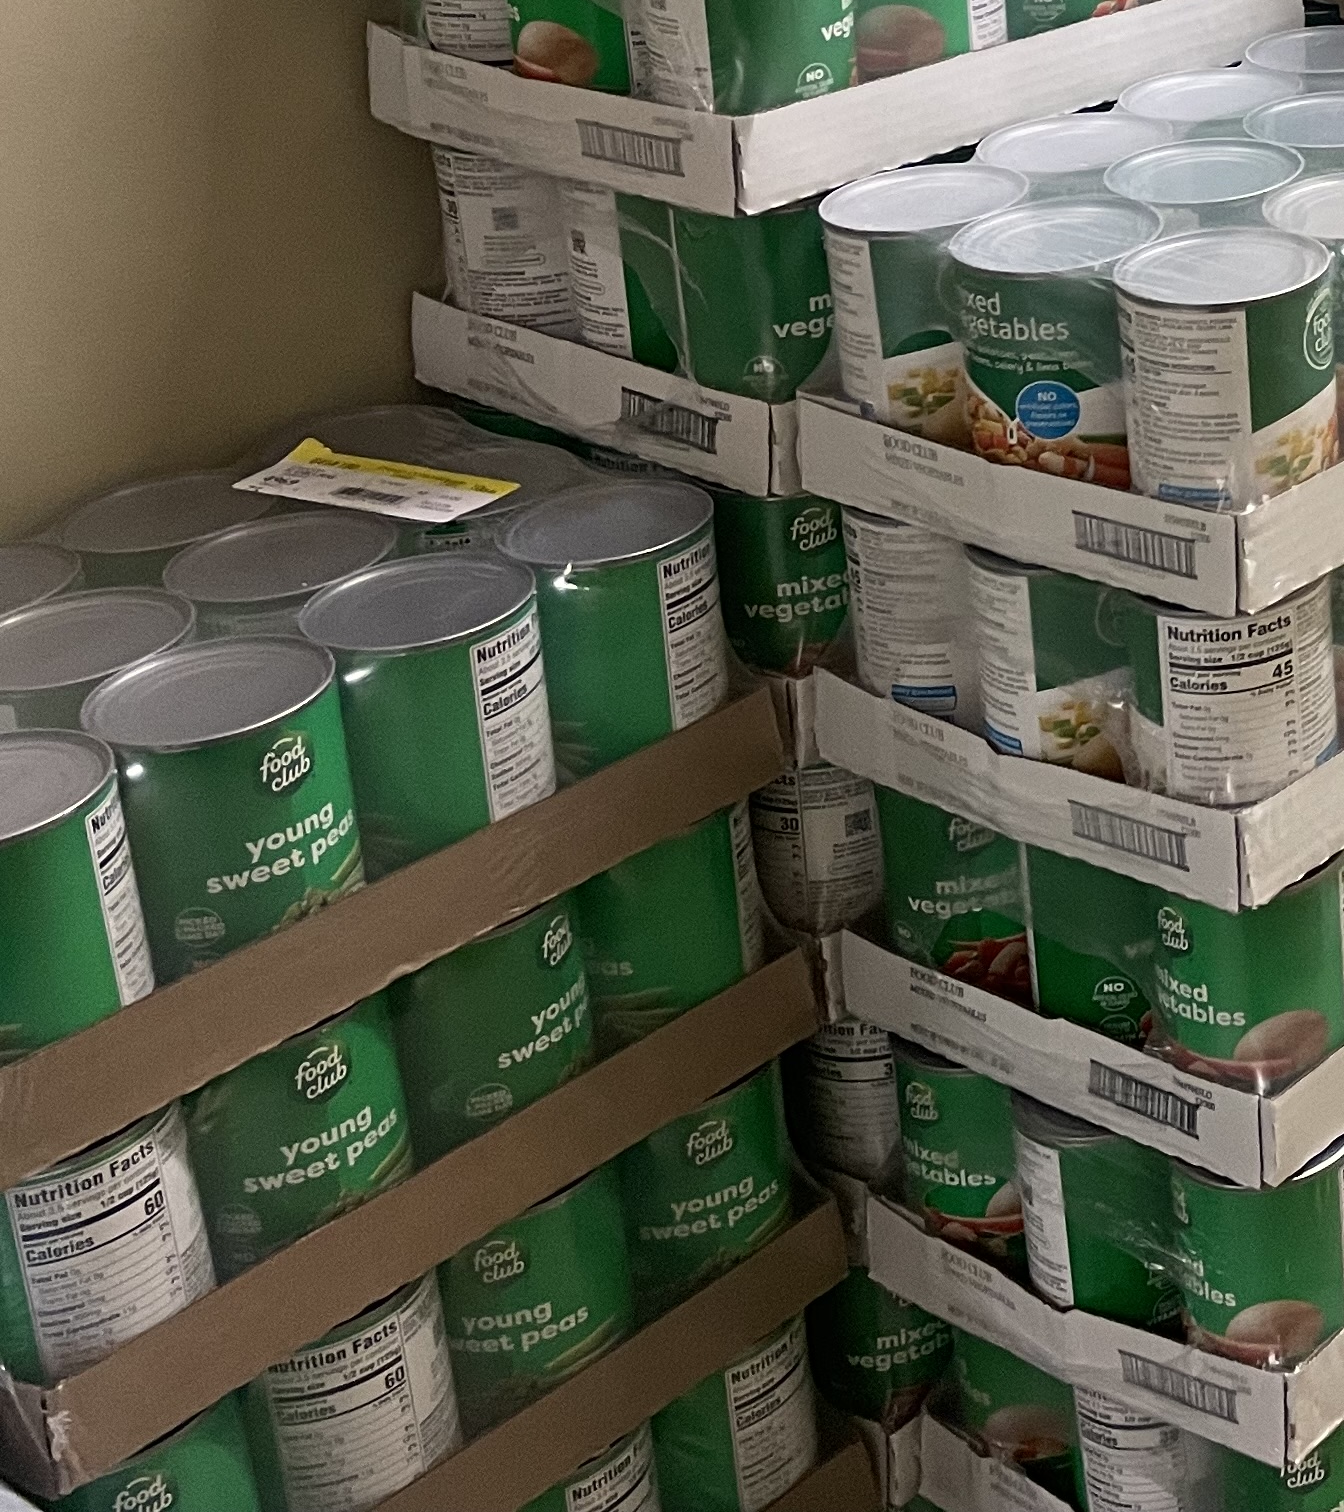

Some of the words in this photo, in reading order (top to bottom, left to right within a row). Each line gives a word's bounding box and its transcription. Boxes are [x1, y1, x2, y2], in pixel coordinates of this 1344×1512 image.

[806, 68, 825, 82] NO
[966, 291, 1001, 316] xed
[1037, 391, 1057, 401] NO
[790, 508, 833, 542] food
[799, 527, 837, 552] club
[668, 600, 708, 629] Calories
[1167, 626, 1242, 643] Nutrition
[1248, 615, 1291, 638] Facts
[476, 622, 532, 664] Nutrition
[1170, 677, 1228, 691] Calories
[1272, 659, 1293, 678] 45
[483, 684, 527, 716] Calories
[261, 736, 304, 782] food
[271, 756, 311, 792] club
[245, 802, 334, 863] young
[780, 815, 800, 832] 30
[206, 849, 305, 895] sweet
[312, 807, 354, 865] peas
[1157, 911, 1185, 935] food
[1162, 927, 1189, 951] club
[1102, 981, 1125, 993] NO
[1162, 995, 1246, 1028] etables
[499, 1016, 573, 1069] sweet
[295, 1046, 341, 1090] food
[306, 1062, 348, 1100] club
[910, 1102, 939, 1121] club
[243, 1156, 341, 1194] sweet
[346, 1110, 398, 1166] peas
[280, 1105, 371, 1168] young
[686, 1123, 727, 1155] food
[696, 1135, 733, 1165] club
[13, 1172, 103, 1208] Nutrition
[109, 1141, 154, 1177] Facts
[908, 1164, 996, 1186] etables
[144, 1190, 164, 1216] 60
[639, 1214, 722, 1241] sweet
[727, 1178, 779, 1227] peas
[670, 1176, 754, 1220] young
[25, 1237, 95, 1262] Calories
[474, 1242, 518, 1272] food
[482, 1257, 525, 1283] club
[461, 1302, 553, 1333] young
[521, 1305, 589, 1352] peas
[351, 1319, 399, 1355] Facts
[384, 1365, 405, 1390] 60
[731, 1340, 788, 1386] Nutrition
[736, 1396, 781, 1428] Calories
[112, 1474, 167, 1512] food
[572, 1453, 632, 1502] Nutrition
[1287, 1467, 1325, 1489] club
